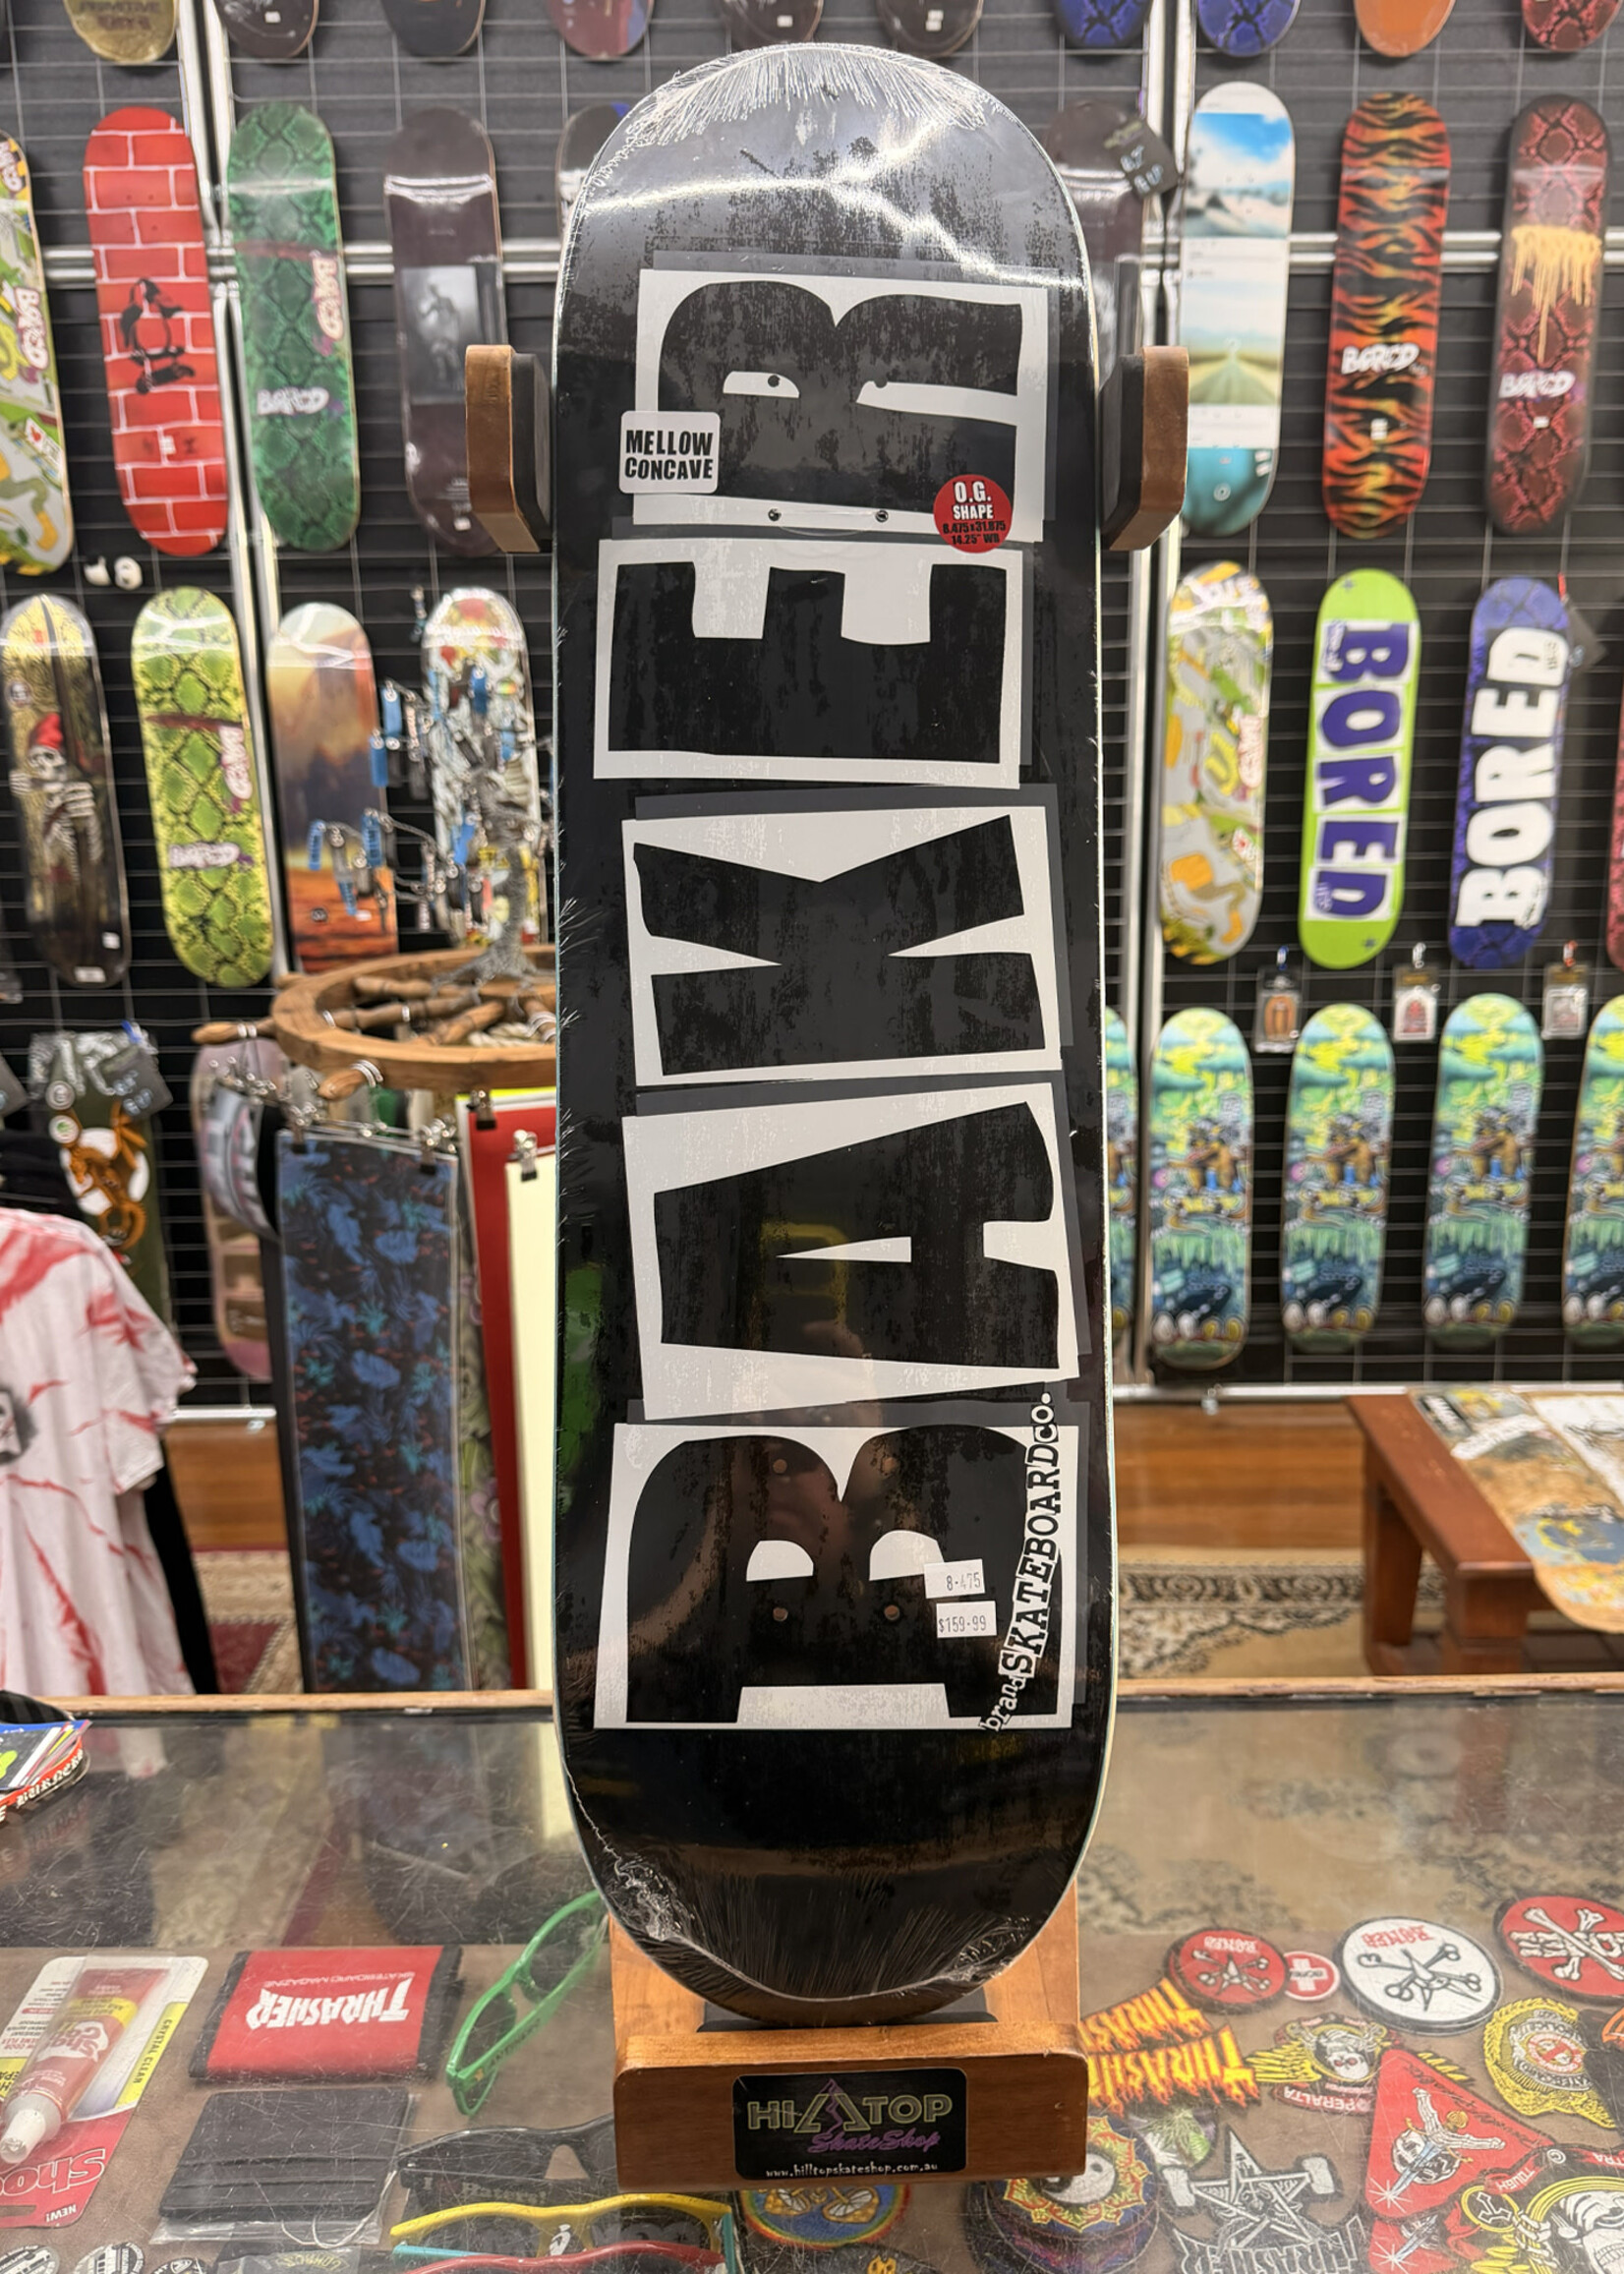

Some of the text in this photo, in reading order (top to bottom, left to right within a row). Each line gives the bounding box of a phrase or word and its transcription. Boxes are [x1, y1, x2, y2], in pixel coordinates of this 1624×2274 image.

[624, 429, 714, 457] MELLOW
[624, 457, 714, 481] CONCAVE
[954, 481, 992, 503] O.G.
[953, 503, 994, 520] SHAPE
[1317, 622, 1410, 916] BORED
[1455, 626, 1570, 927] BORED
[602, 275, 1066, 1726] BAKER
[998, 1441, 1061, 1677] SKATEBOARD
[245, 1978, 414, 2030] THRASHER
[1078, 1977, 1214, 2053] THRAS
[133, 2018, 173, 2083] CRYSTAL CLEAR
[1087, 2024, 1261, 2118] THRASH
[1283, 2084, 1357, 2111] PERALTA
[0, 2148, 106, 2197] Sho
[766, 2161, 938, 2178] www.hilltopskateshop.com.au
[1494, 2166, 1537, 2191] TOUGH
[1592, 2151, 1624, 2168] TRA
[45, 2203, 78, 2223] NEW!
